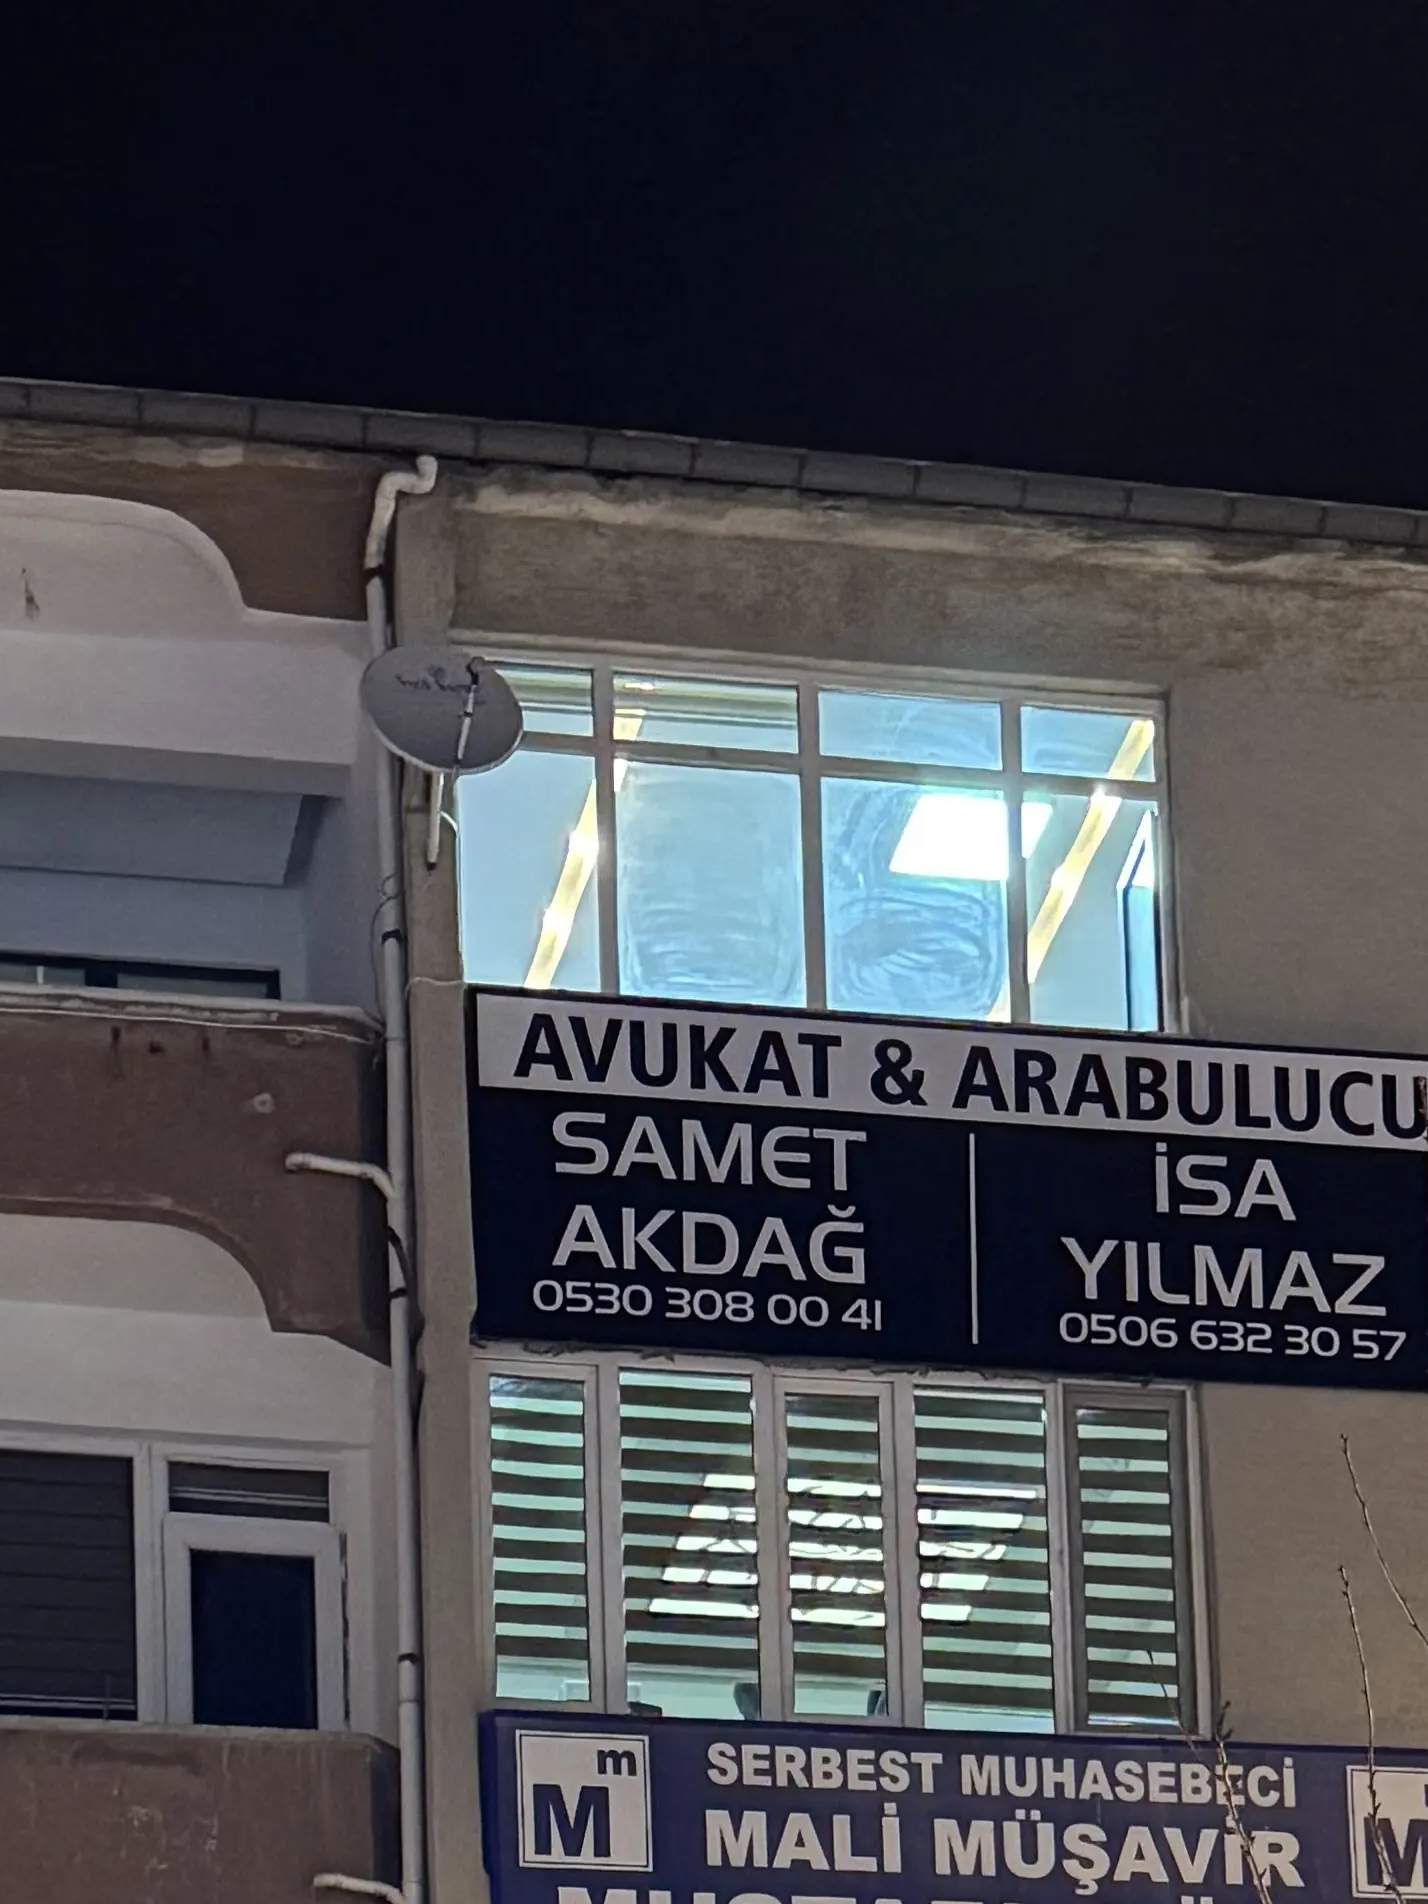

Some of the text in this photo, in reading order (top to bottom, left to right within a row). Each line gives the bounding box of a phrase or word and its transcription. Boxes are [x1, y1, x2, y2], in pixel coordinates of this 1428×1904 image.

[514, 1012, 1427, 1141] AVUKAT & ARABULUCU
[552, 1111, 868, 1192] SAMET
[1154, 1142, 1296, 1222] İSA
[552, 1203, 867, 1286] AKDAĞ
[1059, 1236, 1387, 1318] YILMAZ
[534, 1279, 883, 1332] 0530 308 00 41
[1059, 1312, 1407, 1363] 0506 632 30 57
[706, 1742, 1298, 1811] SERBEST MUHASEBECİ
[705, 1802, 1303, 1896] MALİ MÜŞAVİR
